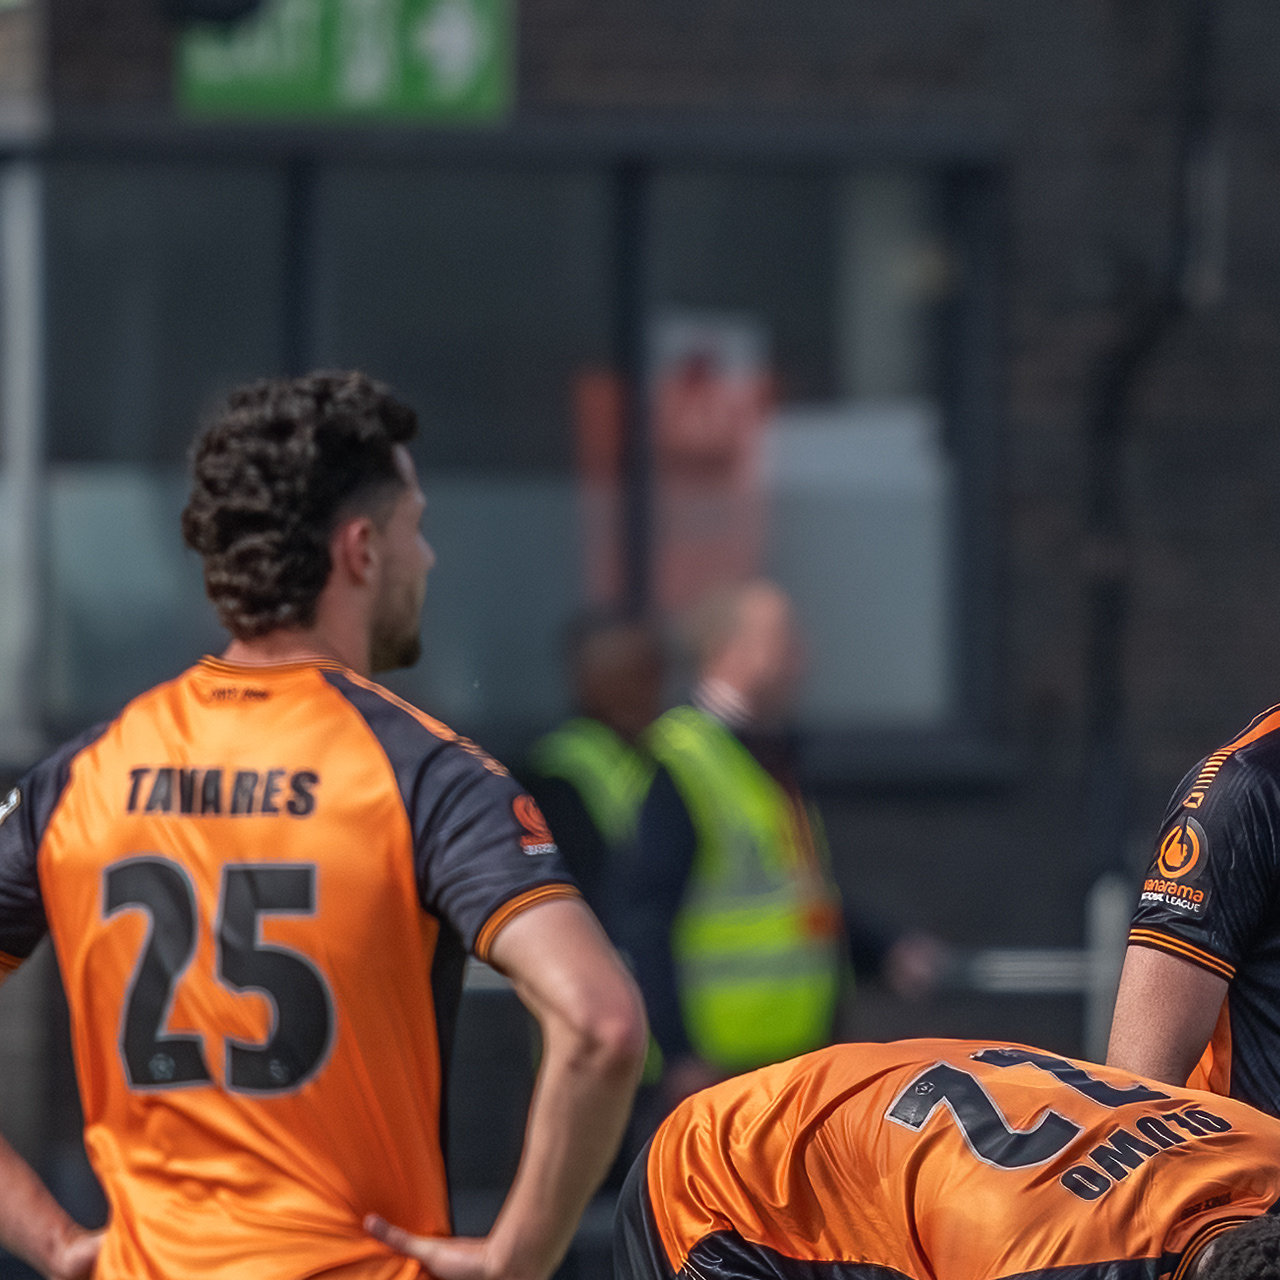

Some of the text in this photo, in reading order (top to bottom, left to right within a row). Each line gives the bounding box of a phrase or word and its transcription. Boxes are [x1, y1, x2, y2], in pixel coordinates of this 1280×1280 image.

[126, 767, 320, 817] TAVARES
[1165, 894, 1201, 913] LEAGUE
[102, 855, 337, 1096] 25
[1059, 1108, 1233, 1202] OLUWO
